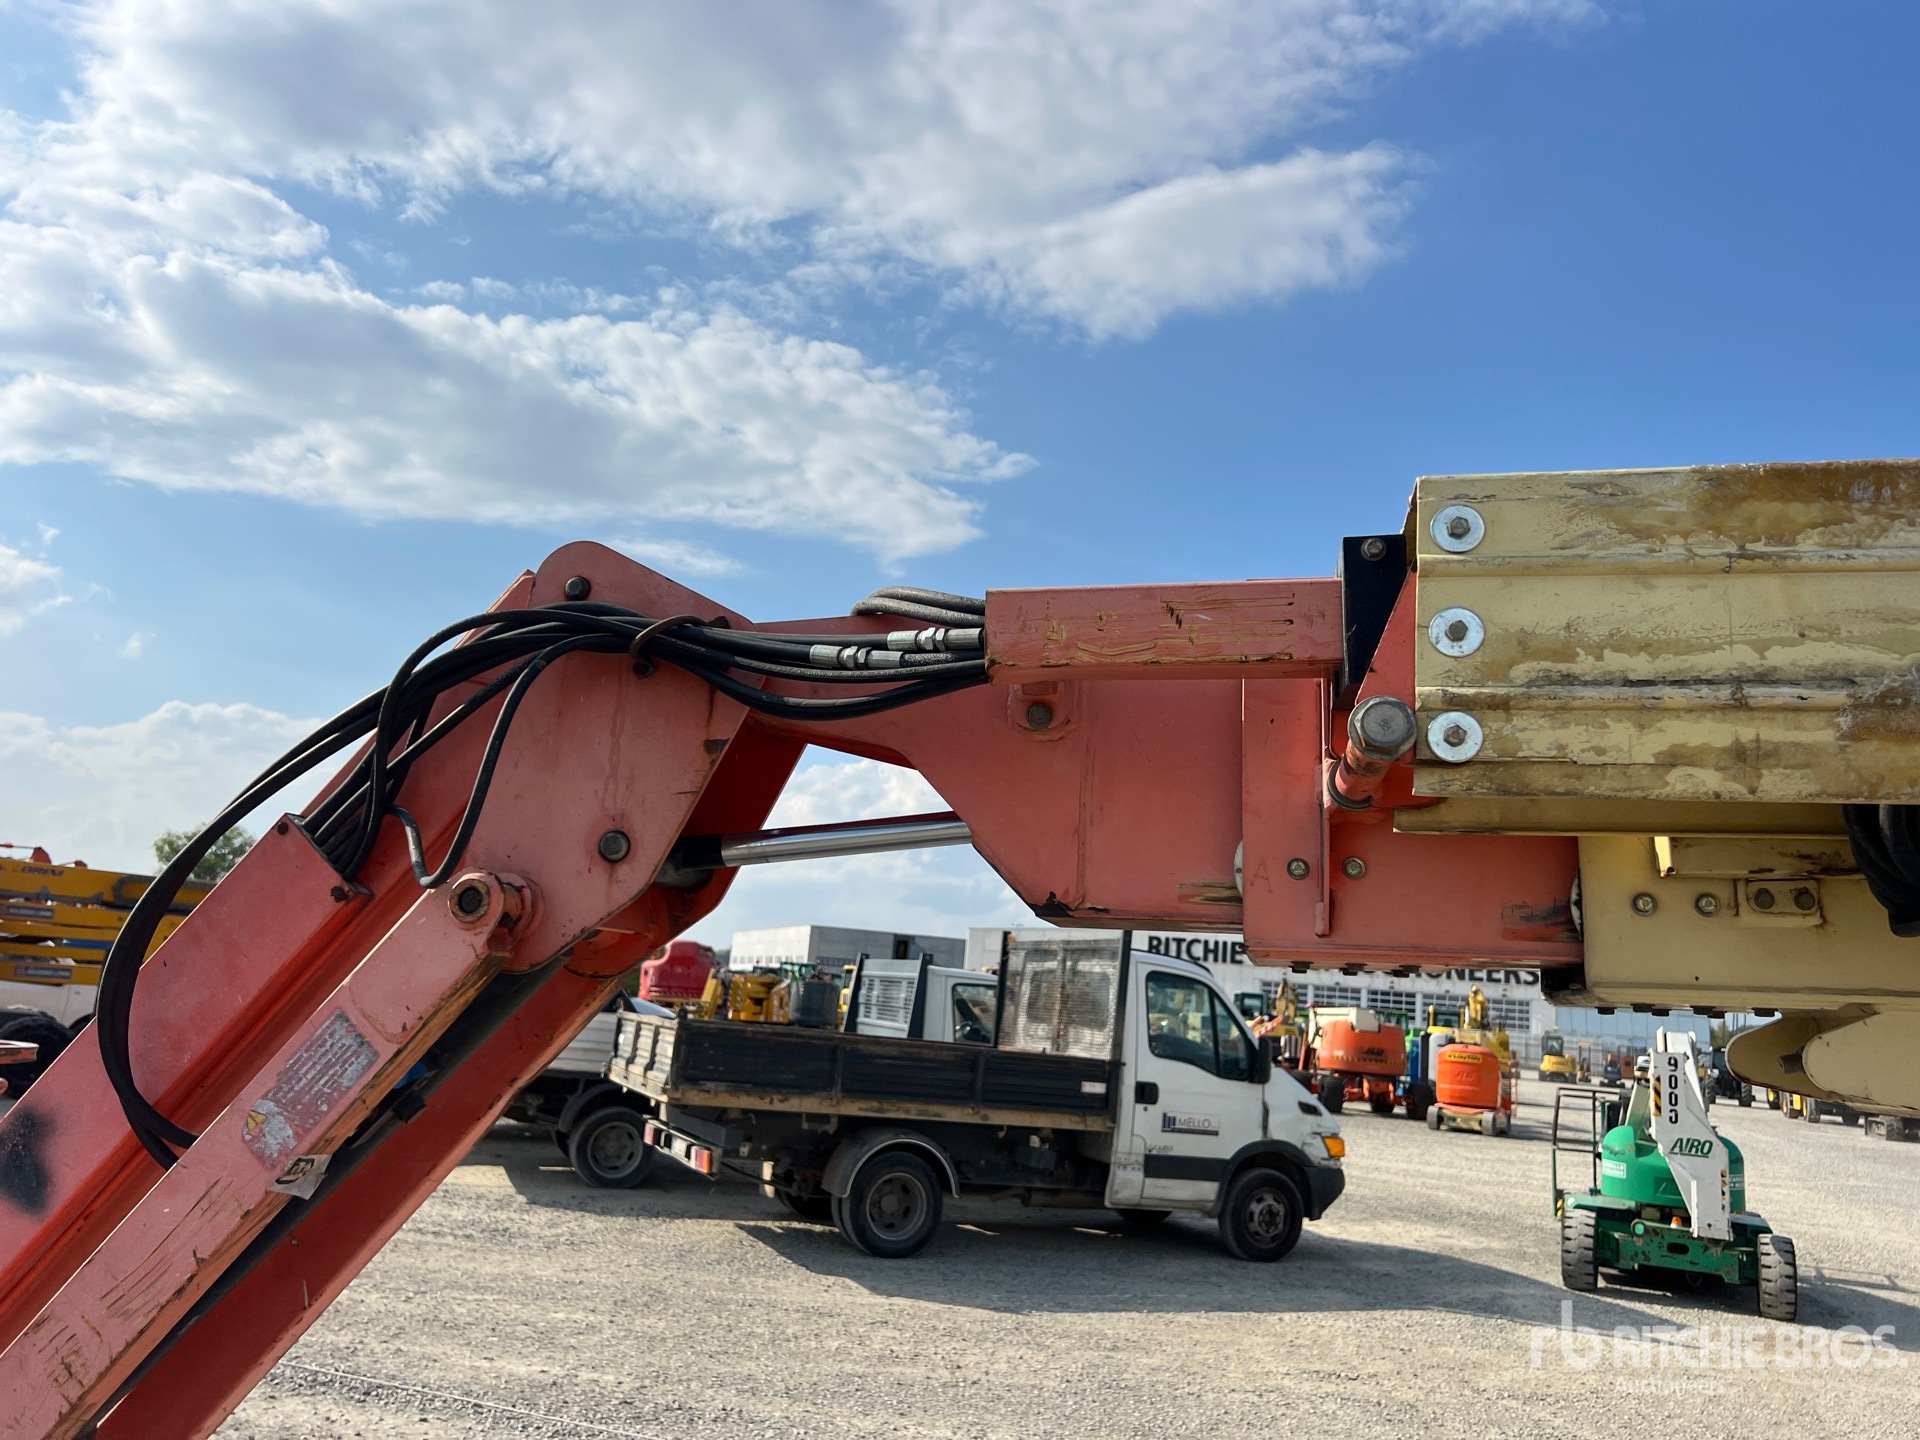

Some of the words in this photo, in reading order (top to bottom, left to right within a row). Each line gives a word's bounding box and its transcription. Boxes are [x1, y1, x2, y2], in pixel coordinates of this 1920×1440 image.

[1149, 935, 1244, 964] RITCHIE
[1667, 1056, 1679, 1125] 9000
[1178, 1116, 1212, 1129] MELLO
[1670, 1137, 1714, 1156] AIRO
